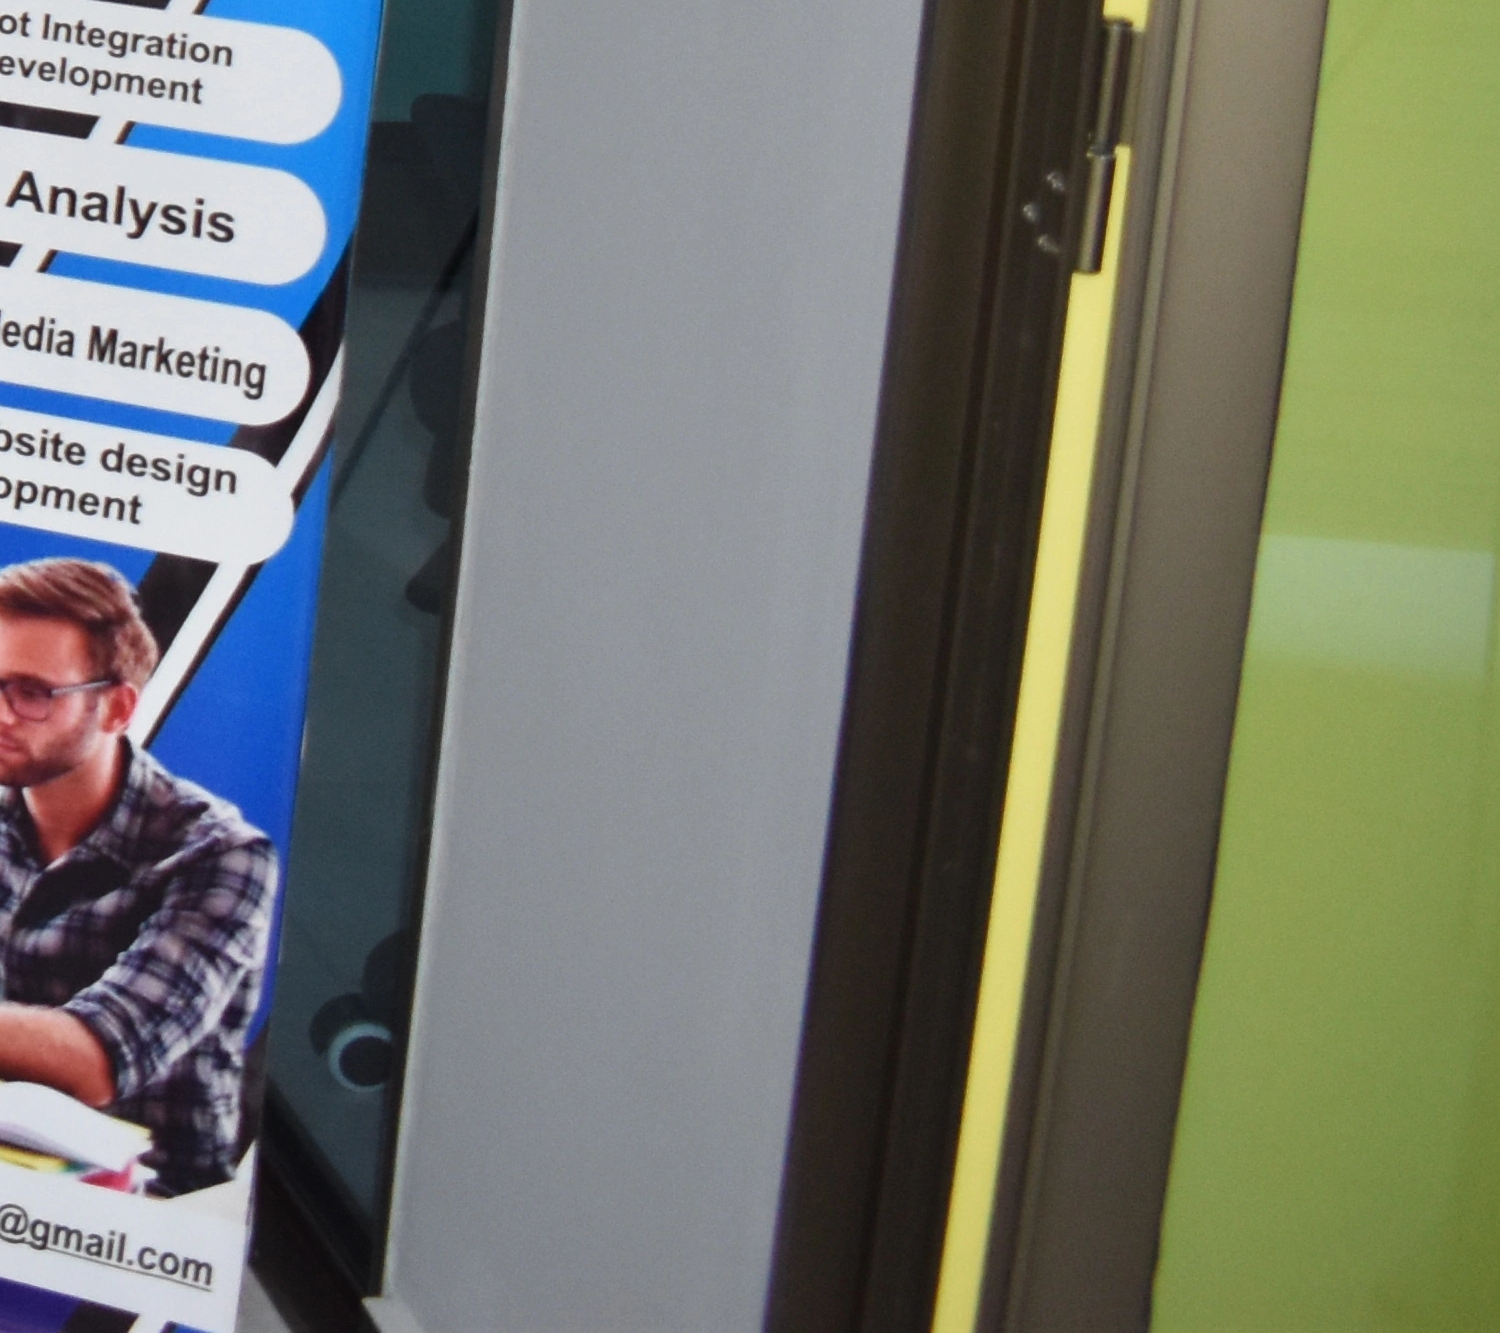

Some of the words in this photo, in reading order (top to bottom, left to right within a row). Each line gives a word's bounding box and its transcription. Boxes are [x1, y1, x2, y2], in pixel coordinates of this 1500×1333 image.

[43, 14, 232, 66] Integration
[6, 171, 234, 242] Analysis
[88, 326, 266, 400] Marketing
[100, 443, 236, 497] design
